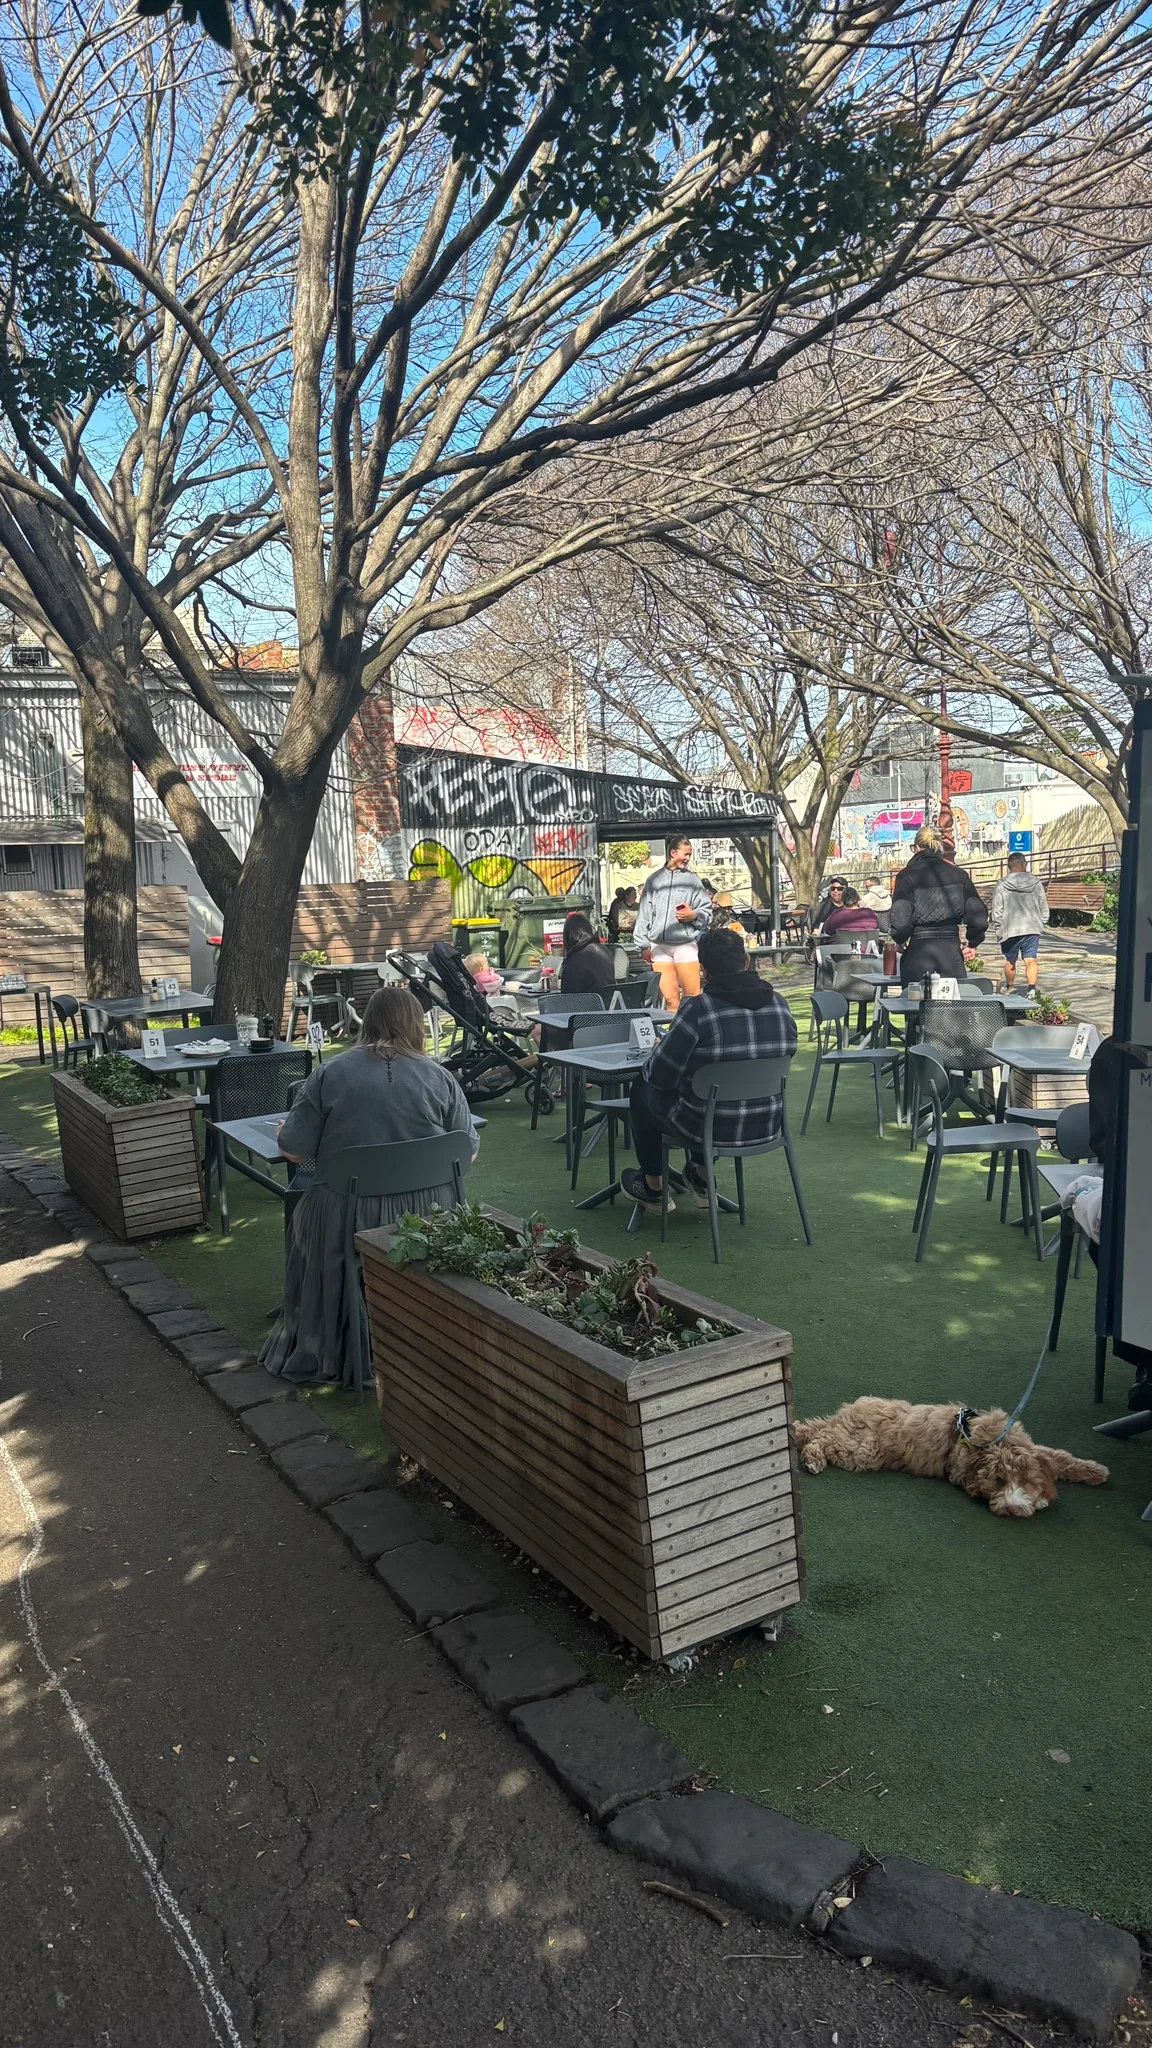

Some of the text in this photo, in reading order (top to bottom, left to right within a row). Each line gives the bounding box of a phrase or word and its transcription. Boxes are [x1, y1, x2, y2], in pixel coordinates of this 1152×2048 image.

[198, 774, 237, 782] STORE
[464, 827, 525, 852] ODA!
[640, 1027, 651, 1036] 52
[149, 1037, 160, 1047] 51
